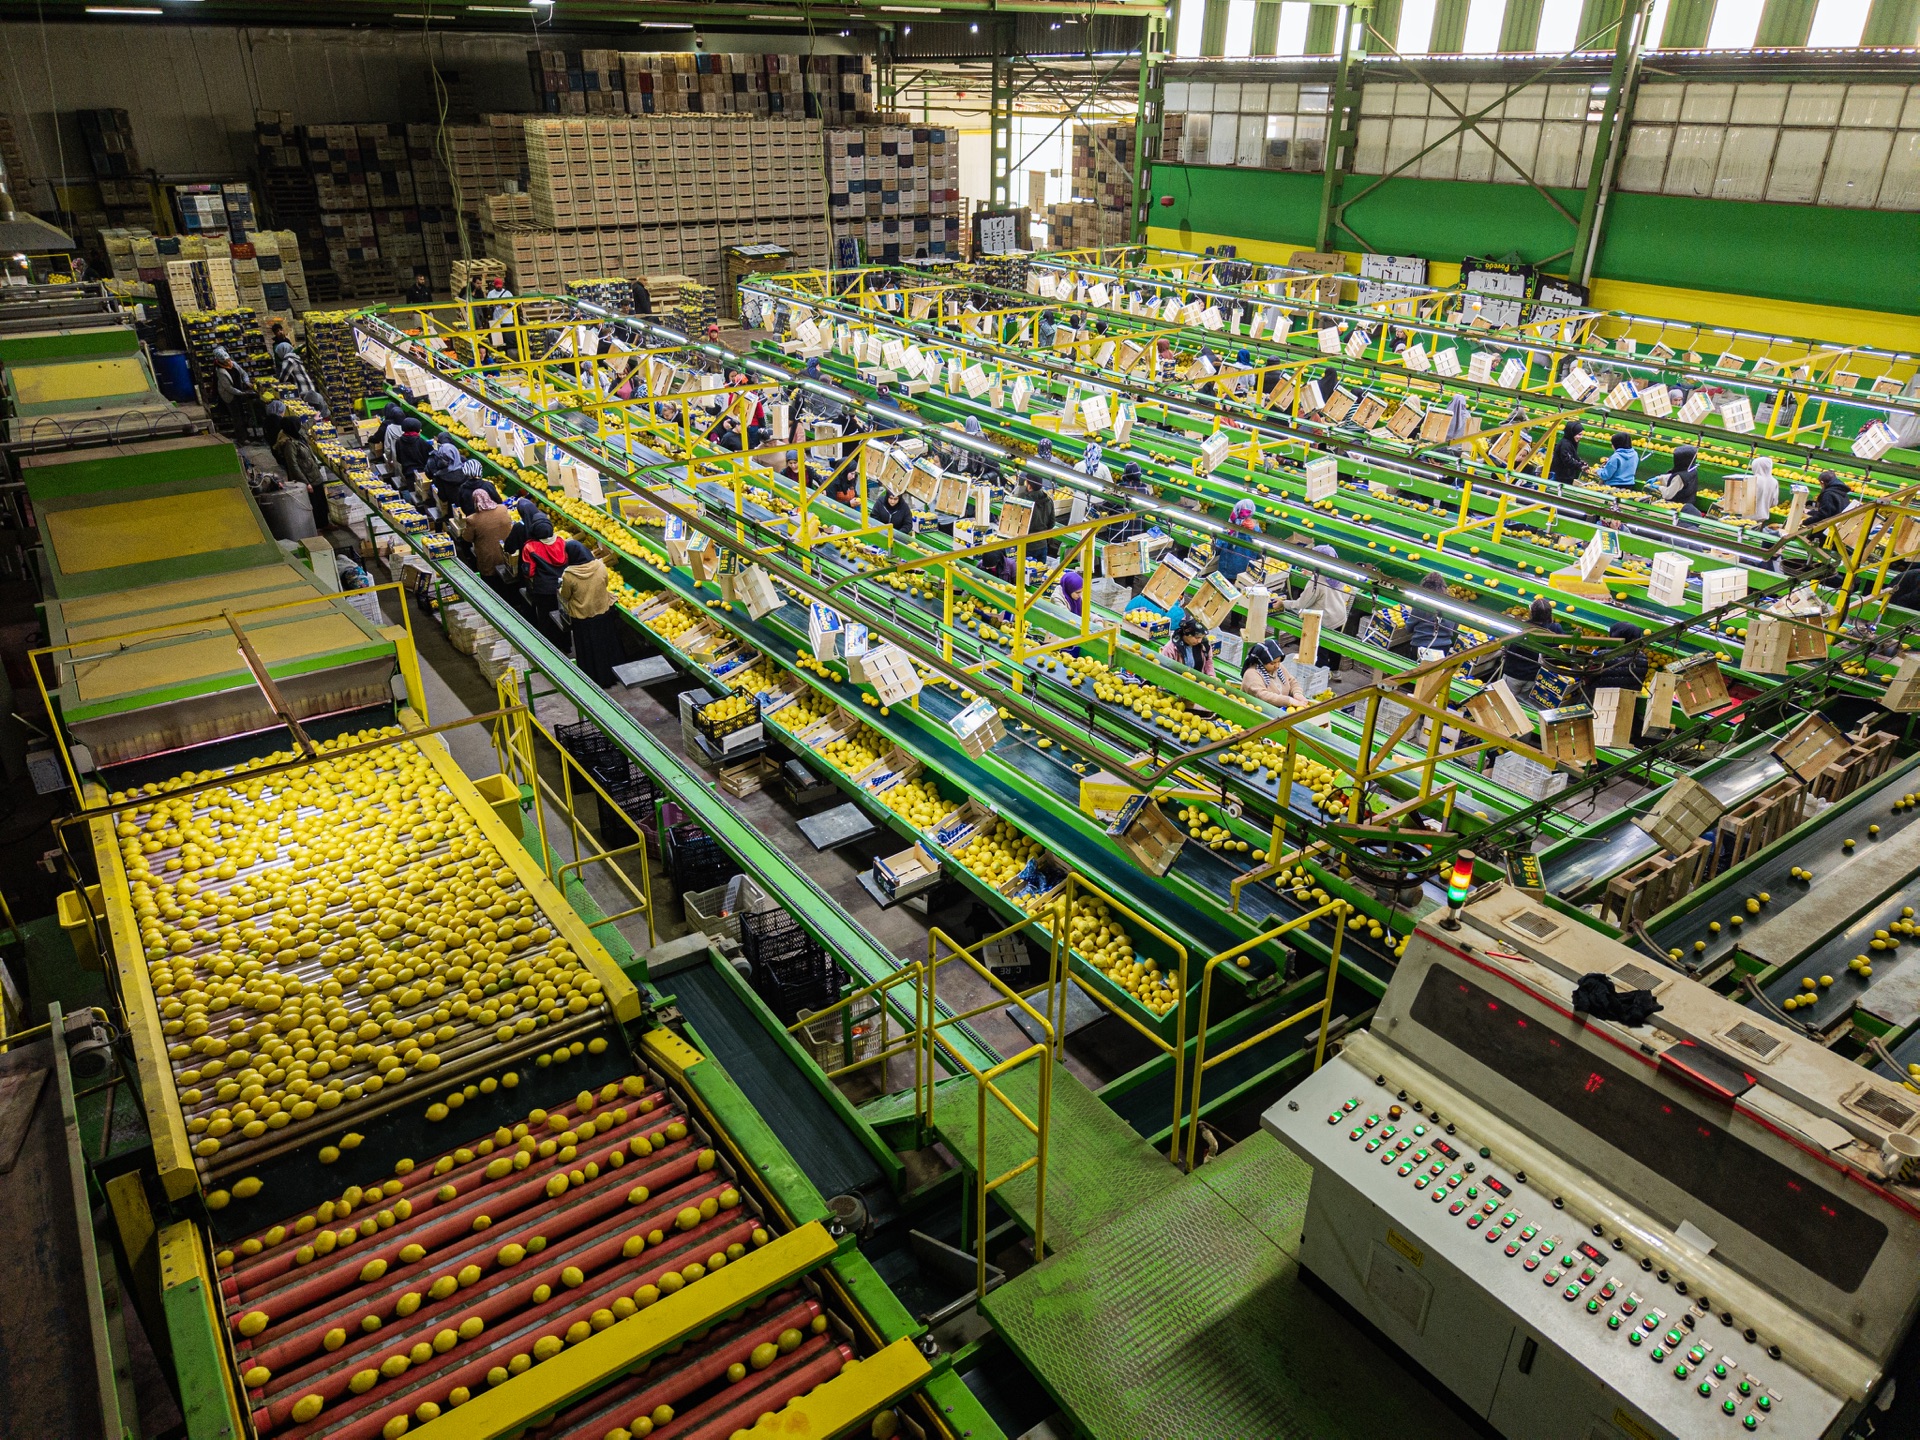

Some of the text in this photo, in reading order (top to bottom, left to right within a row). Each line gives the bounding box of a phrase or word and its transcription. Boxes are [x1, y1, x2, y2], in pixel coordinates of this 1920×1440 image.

[430, 551, 453, 559] Povedo
[1536, 673, 1562, 694] Povedo
[1531, 689, 1555, 709] Povedo
